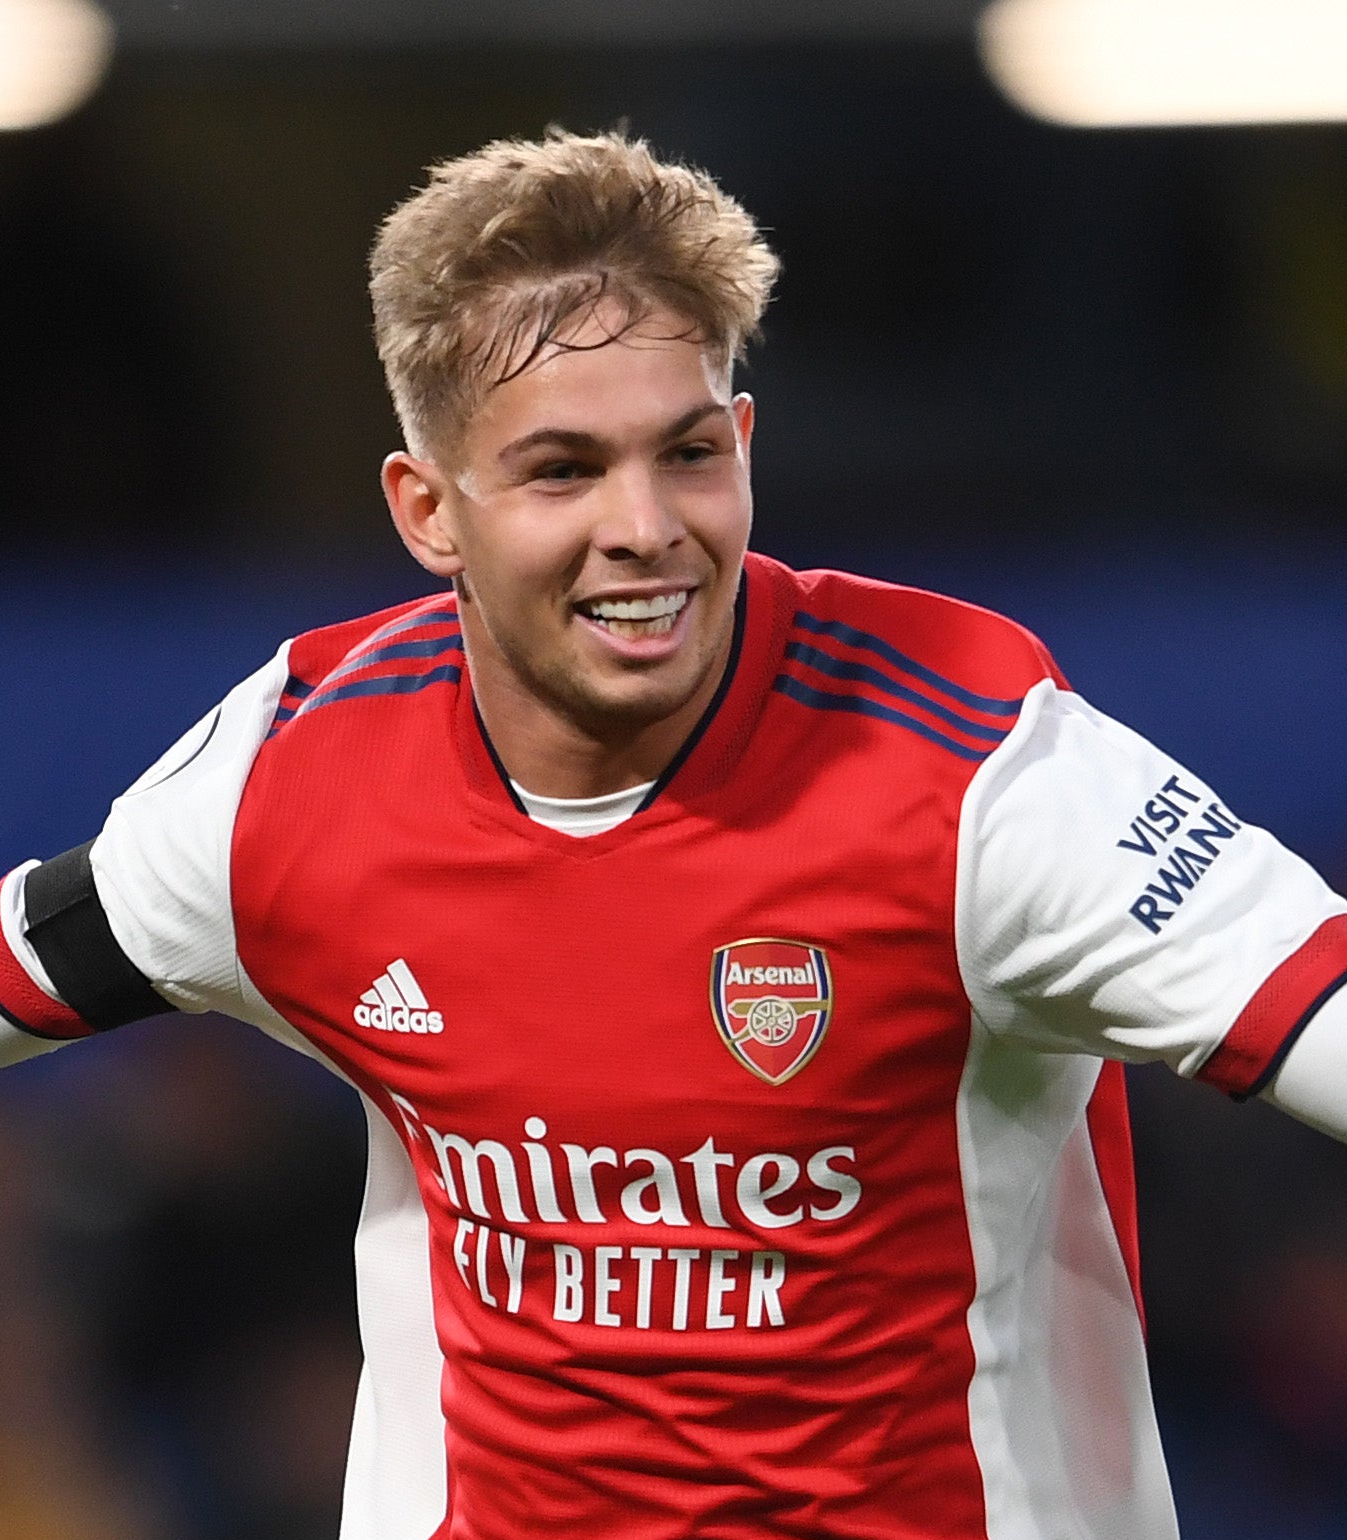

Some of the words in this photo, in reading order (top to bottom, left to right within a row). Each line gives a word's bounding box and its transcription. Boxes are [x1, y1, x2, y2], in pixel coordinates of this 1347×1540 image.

[1115, 774, 1202, 857] VISIT
[726, 962, 815, 986] Arsenal
[353, 1004, 444, 1034] adidas
[454, 1217, 526, 1314] FLY
[553, 1243, 786, 1331] BETTER
